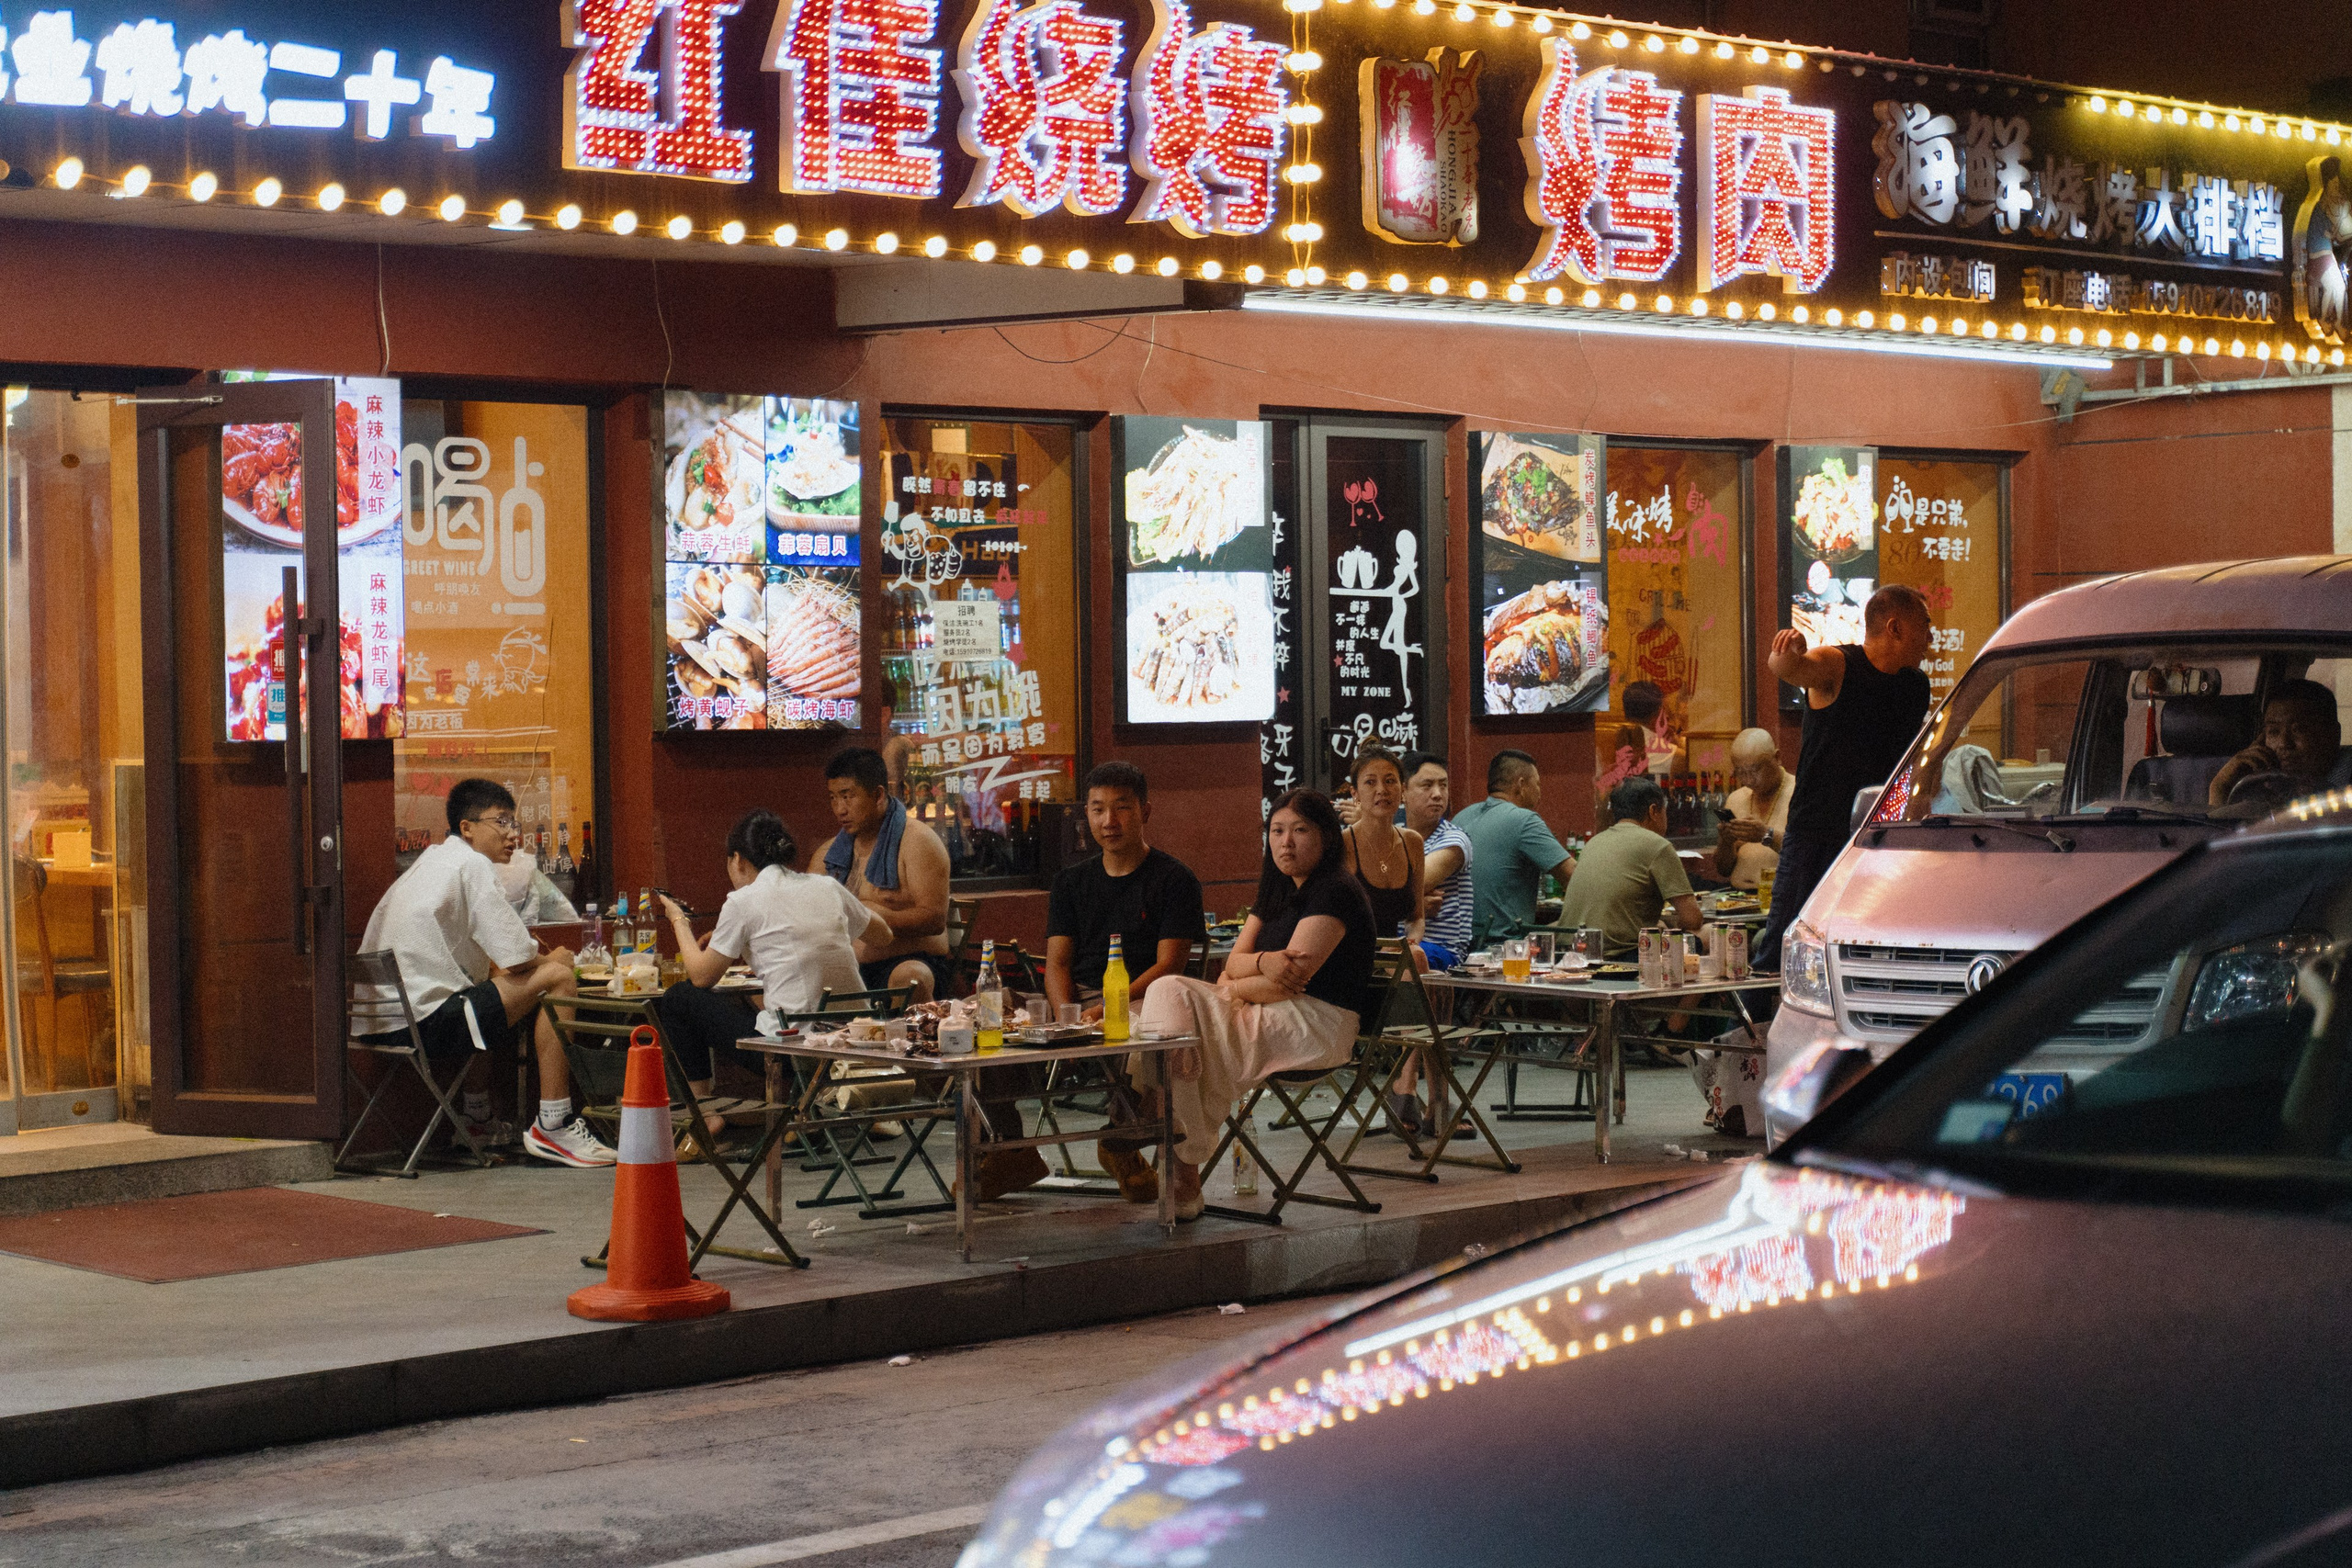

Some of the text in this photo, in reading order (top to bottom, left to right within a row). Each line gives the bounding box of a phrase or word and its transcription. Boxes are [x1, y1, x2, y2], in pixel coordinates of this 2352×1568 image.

[0, 11, 496, 149] 业烧烤二十年
[563, 0, 1289, 238] 红佳烧烤
[1447, 129, 1459, 216] HONGJIA
[1516, 37, 1835, 293] 烤肉
[1439, 160, 1448, 233] SHAOKAO
[1894, 254, 1996, 301] 内设包间
[366, 394, 387, 515] 麻辣小龙虾
[681, 533, 752, 553] 蒜蓉生蚝
[778, 535, 847, 555] 蒜蓉扇贝
[443, 560, 477, 577] WINE
[411, 600, 459, 615] 喝点小酒
[957, 604, 976, 616] 招聘
[1335, 613, 1367, 626] 不一样
[368, 571, 390, 689] 麻辣龙虾尾
[943, 628, 971, 637] 服务员2名
[1350, 626, 1380, 640] 的人生
[1335, 639, 1356, 652] 共度
[1345, 652, 1365, 666] 不凡
[1935, 658, 1954, 672] God
[1340, 665, 1371, 679] 的时光
[1340, 685, 1392, 698] MY ZONE
[678, 698, 750, 719] 烤黄蚬子
[785, 699, 855, 720] 碳烤海虾
[922, 670, 1043, 739] 因为饿
[921, 722, 1046, 767] 而是因为寂寞
[944, 775, 978, 795] 朋友
[1018, 780, 1051, 802] 走起
